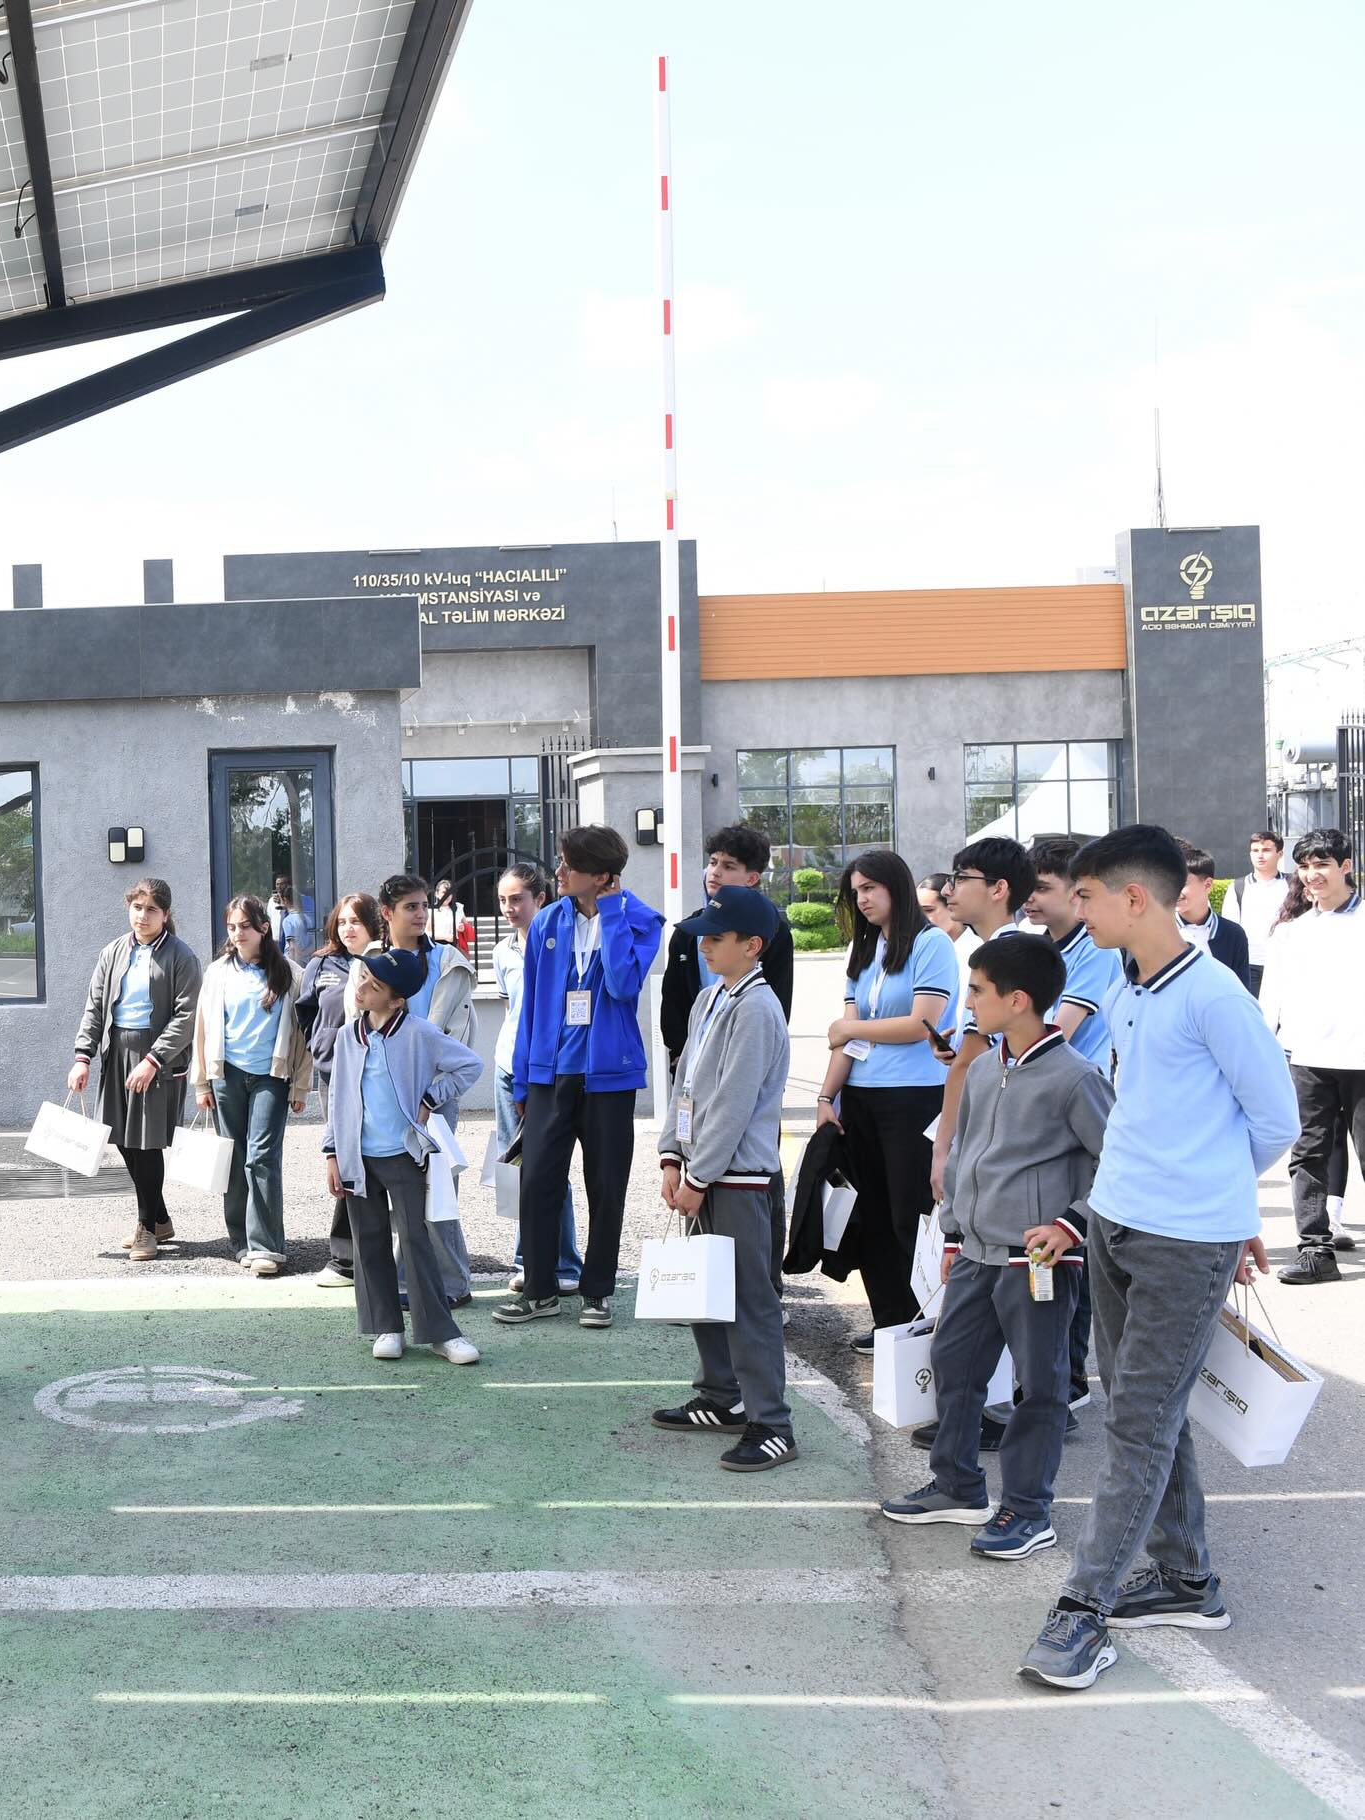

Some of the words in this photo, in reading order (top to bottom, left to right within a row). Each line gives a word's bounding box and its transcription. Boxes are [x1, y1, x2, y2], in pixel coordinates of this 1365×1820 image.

[352, 572, 420, 588] 110/35/10
[424, 571, 471, 587] kV-luq
[522, 591, 541, 601] və
[442, 607, 489, 624] TƏLİM
[493, 605, 566, 622] MƏRKƏZİ
